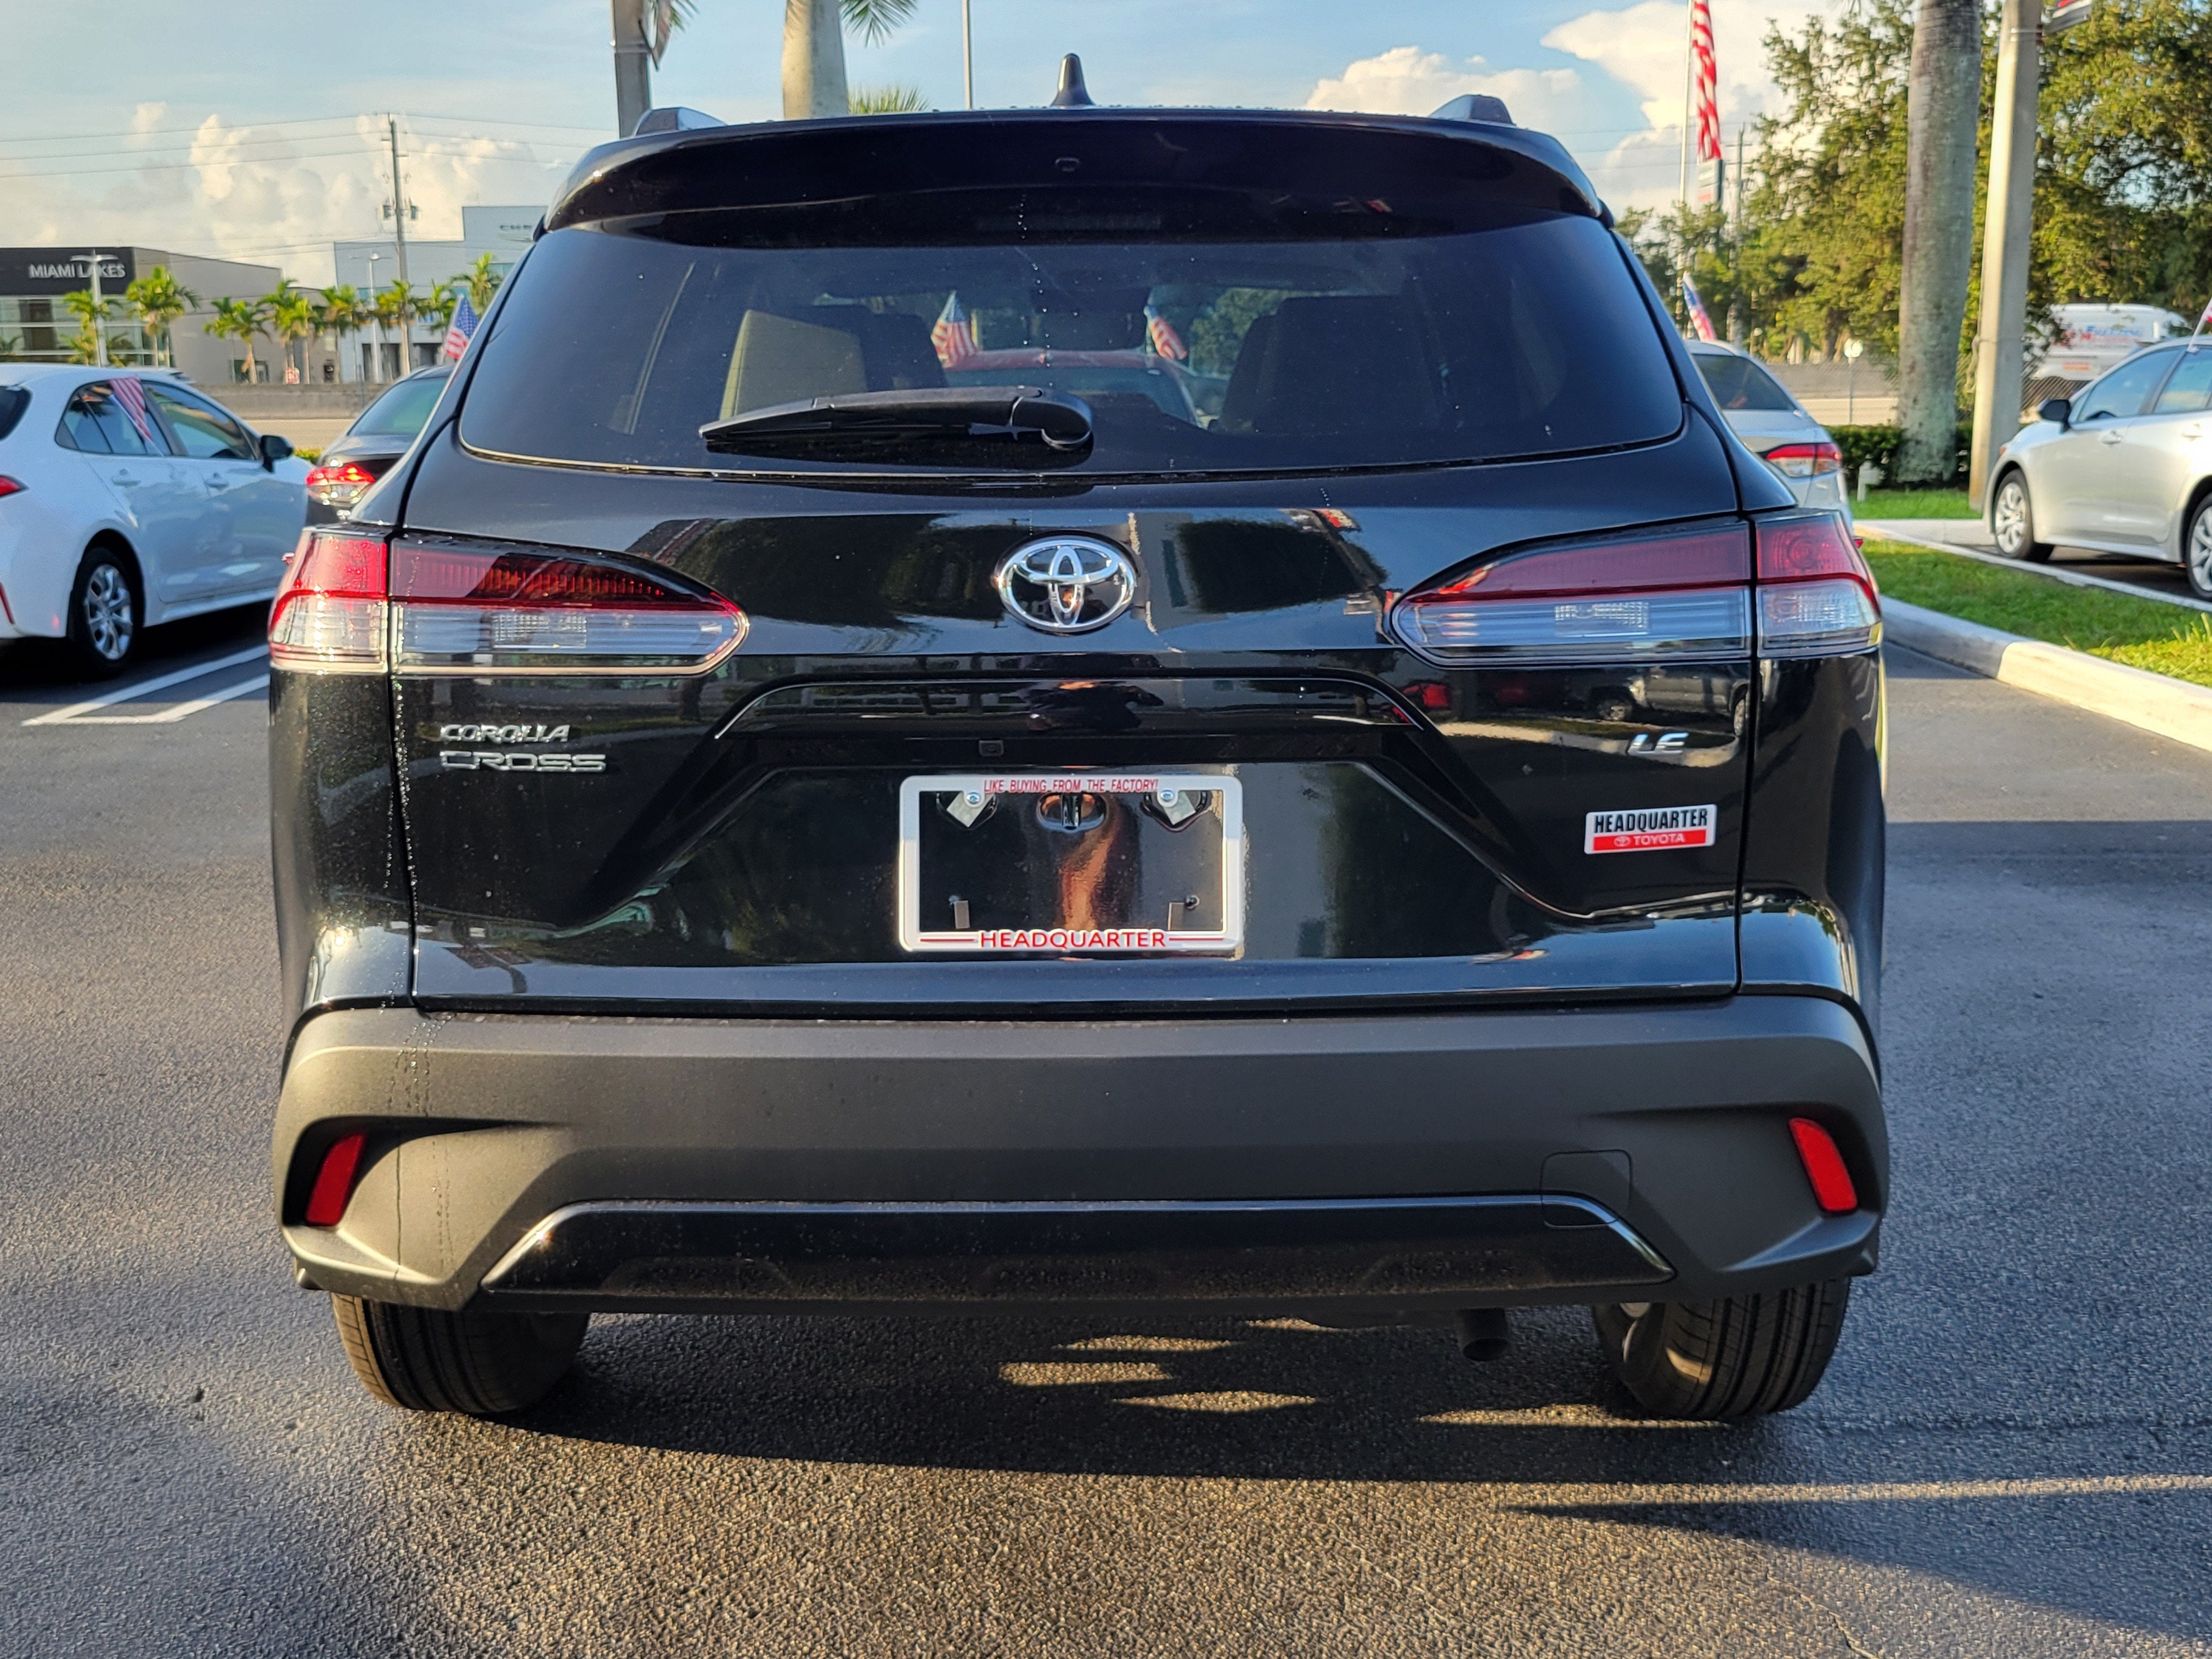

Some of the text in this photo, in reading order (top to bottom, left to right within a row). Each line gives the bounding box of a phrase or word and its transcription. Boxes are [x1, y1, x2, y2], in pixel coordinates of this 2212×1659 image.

[29, 263, 76, 278] MIAMI
[440, 724, 571, 743] COROLLA
[1627, 732, 1690, 755] LE
[439, 750, 606, 772] CROSS
[984, 778, 1159, 792] LIKE BUYING FROM THE FACTORY!
[1594, 808, 1708, 834] HEADQUARTER
[1633, 833, 1686, 846] TOYOTA
[980, 932, 1166, 949] HEADQUARTER
